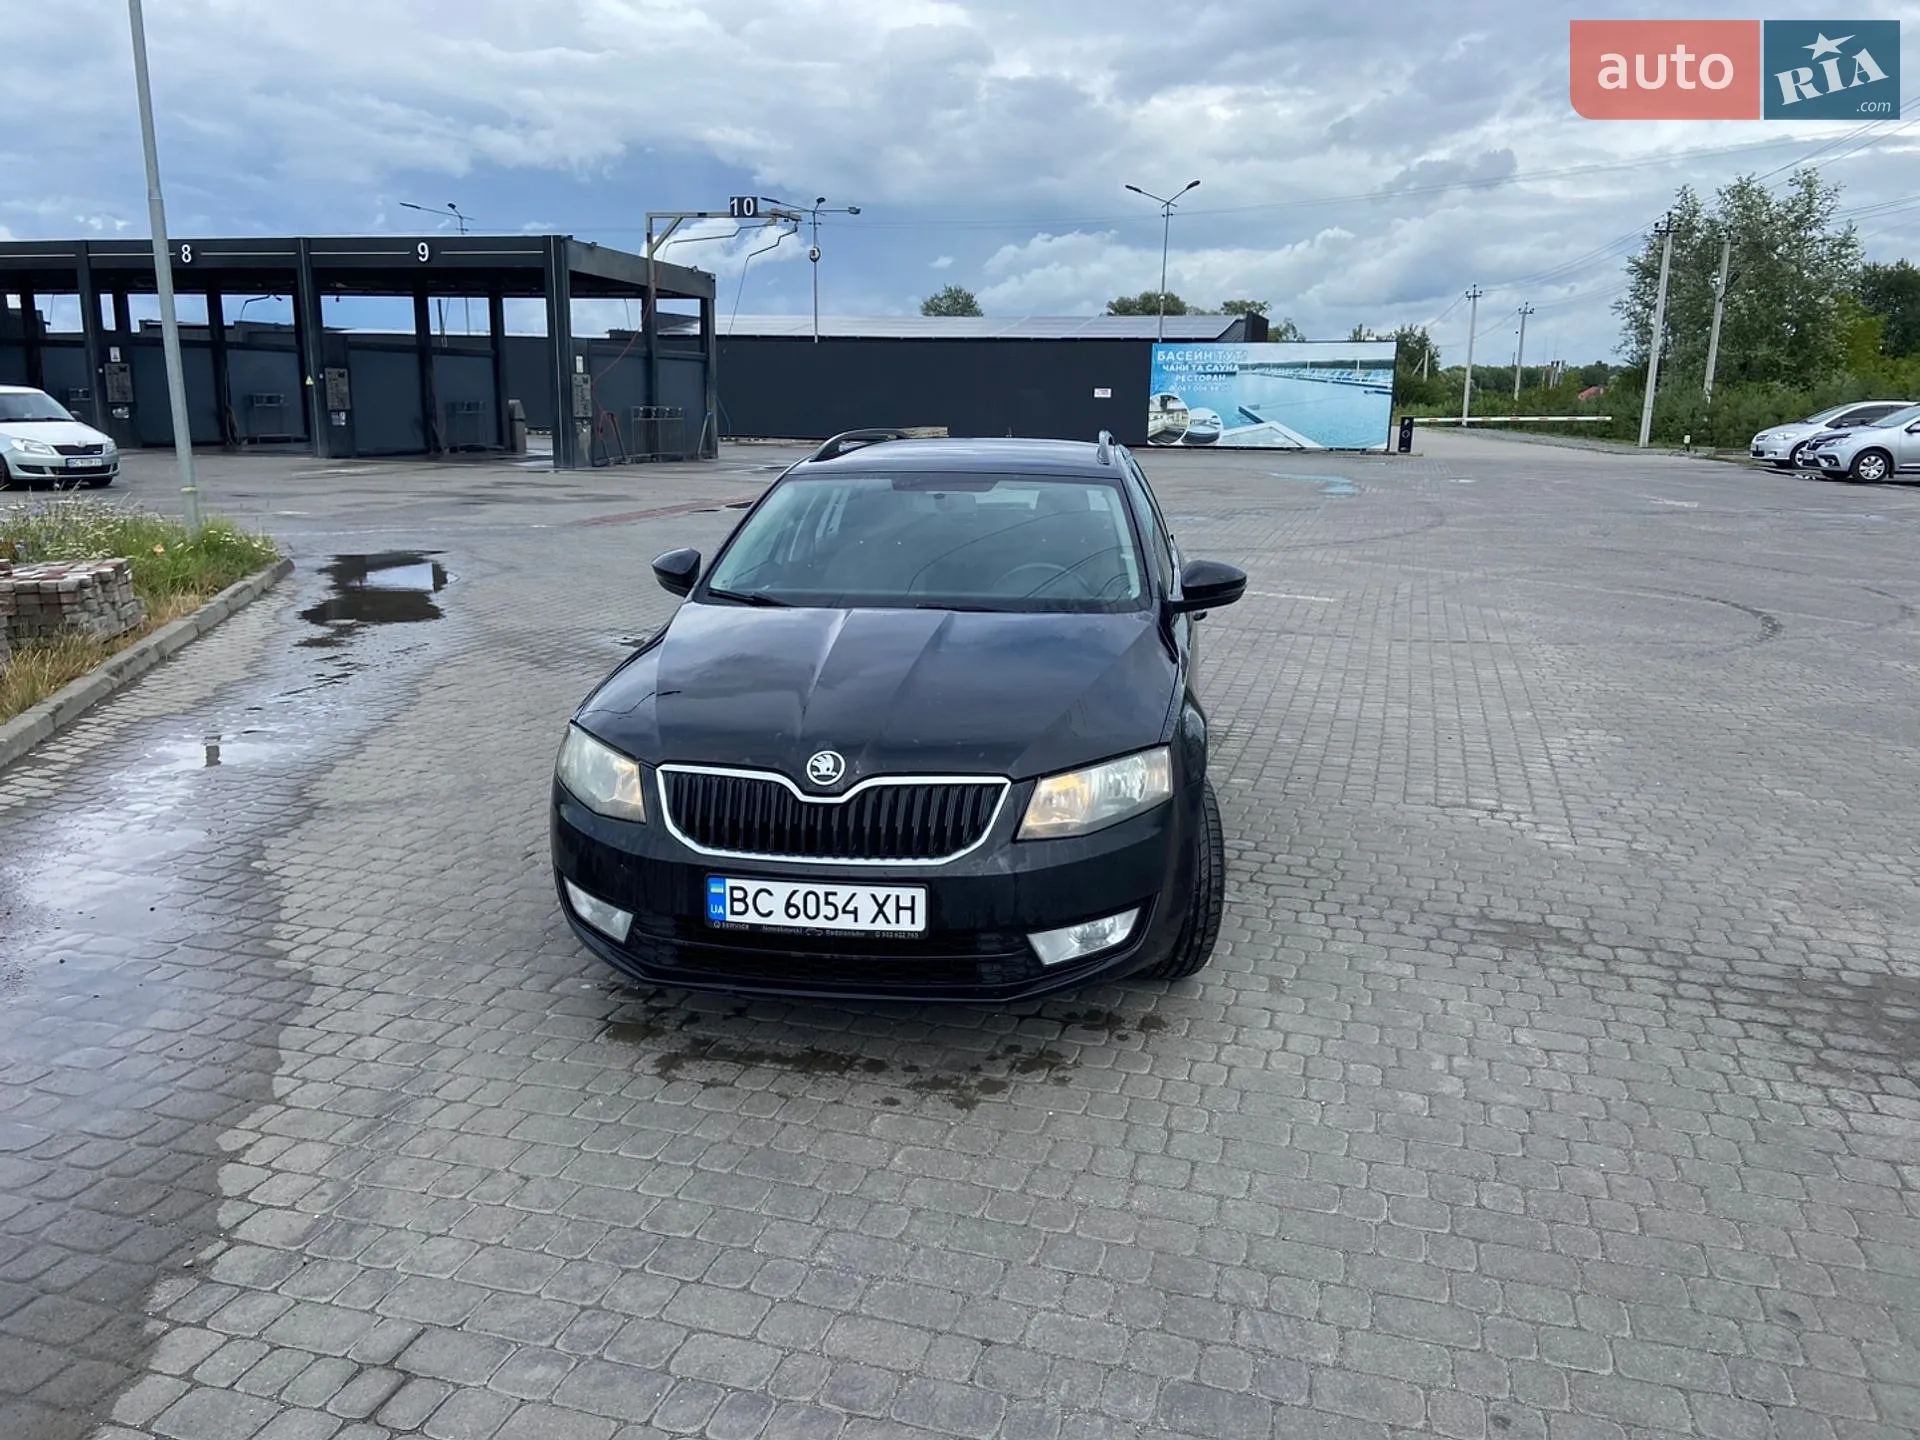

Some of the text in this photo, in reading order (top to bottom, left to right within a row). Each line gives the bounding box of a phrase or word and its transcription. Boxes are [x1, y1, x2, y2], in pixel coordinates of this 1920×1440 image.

[730, 197, 754, 216] 10
[181, 244, 191, 263] 8
[417, 242, 429, 262] 9
[1157, 349, 1212, 361] БАСЕЙН
[1162, 364, 1240, 372] ЧАНИ ТА САУНА
[1175, 374, 1226, 382] РЕСТОРАН
[710, 904, 724, 915] UA
[729, 886, 916, 925] BC 6054 XH
